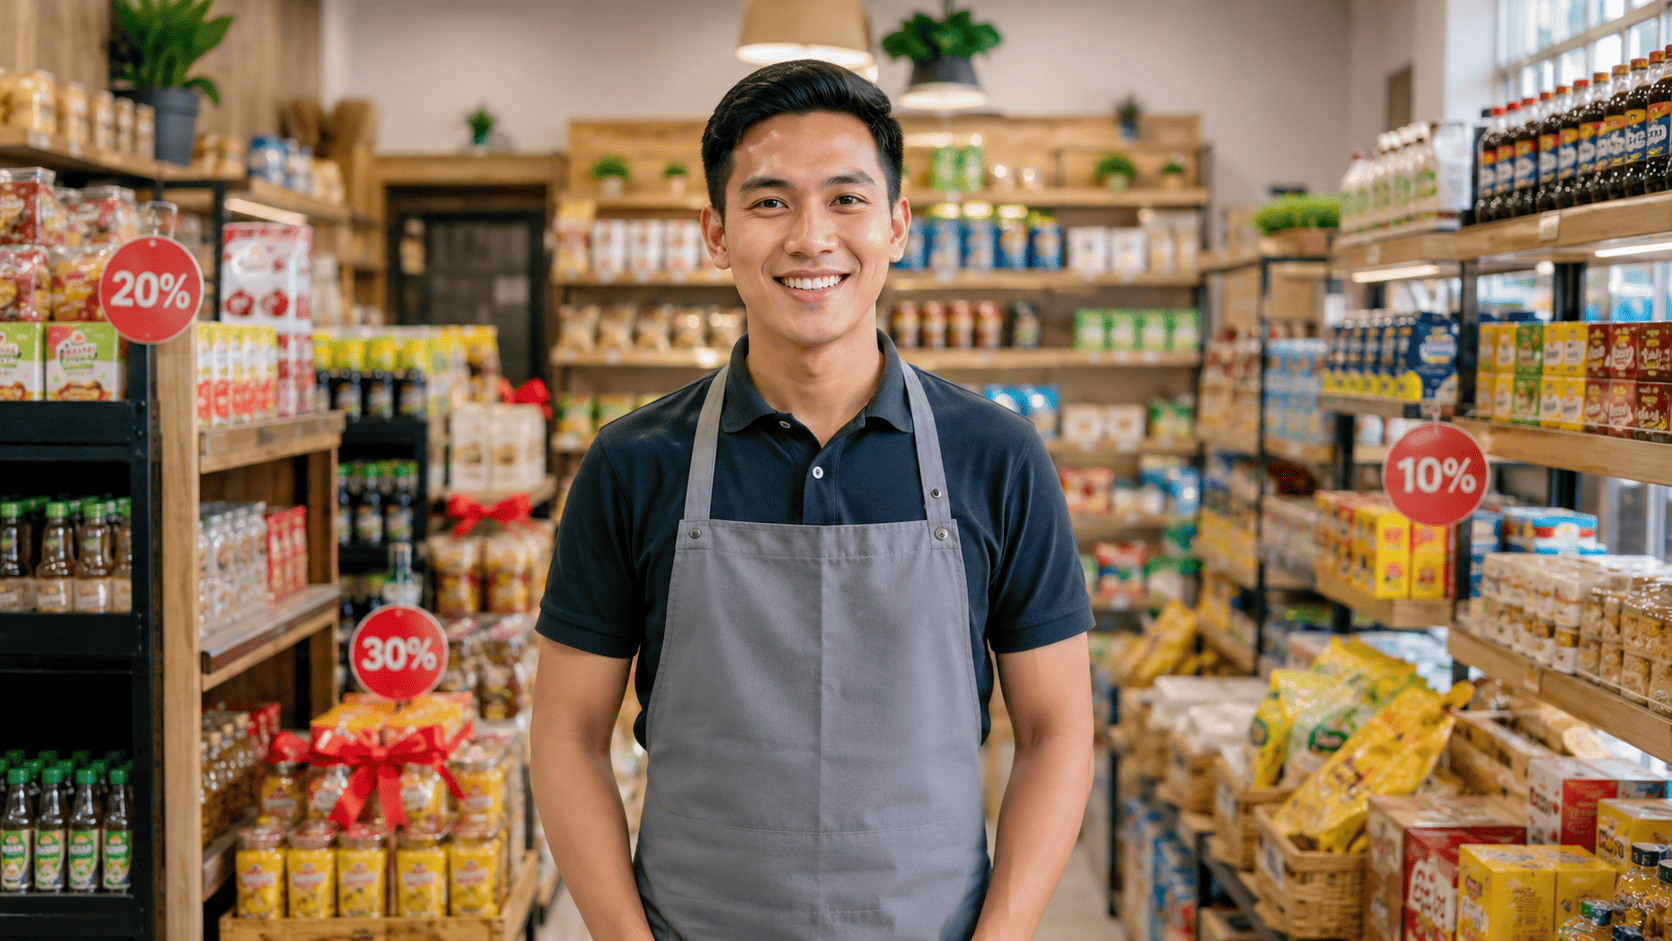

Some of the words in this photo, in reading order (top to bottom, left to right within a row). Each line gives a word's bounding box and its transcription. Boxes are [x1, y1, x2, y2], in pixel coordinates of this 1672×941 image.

[110, 270, 191, 309] 20%
[1398, 457, 1476, 493] 10%
[361, 636, 437, 671] 30%
